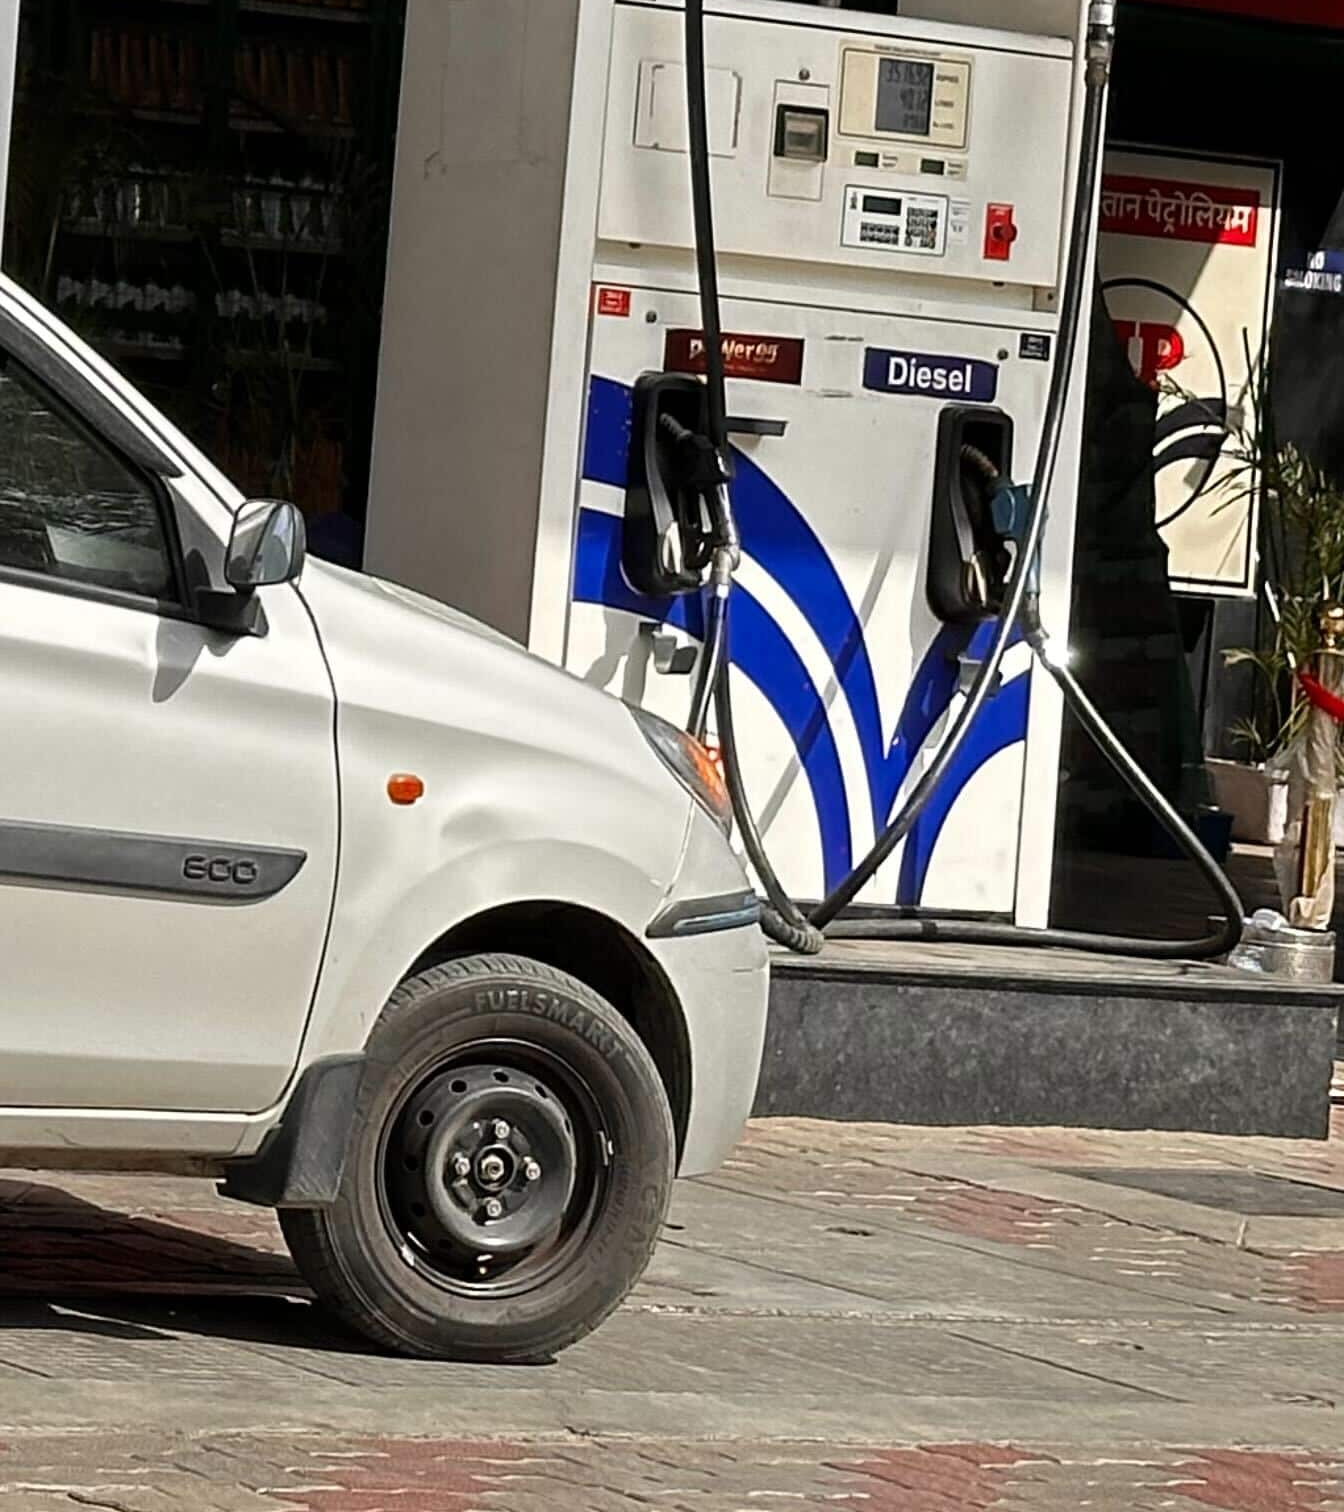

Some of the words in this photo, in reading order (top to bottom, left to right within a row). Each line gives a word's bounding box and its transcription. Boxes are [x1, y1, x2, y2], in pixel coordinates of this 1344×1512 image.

[1101, 190, 1142, 220] तान
[1145, 188, 1251, 234] पेट्रोलियम
[887, 356, 973, 393] Diesel
[182, 854, 258, 885] ECO
[474, 988, 624, 1059] FUELSMART
